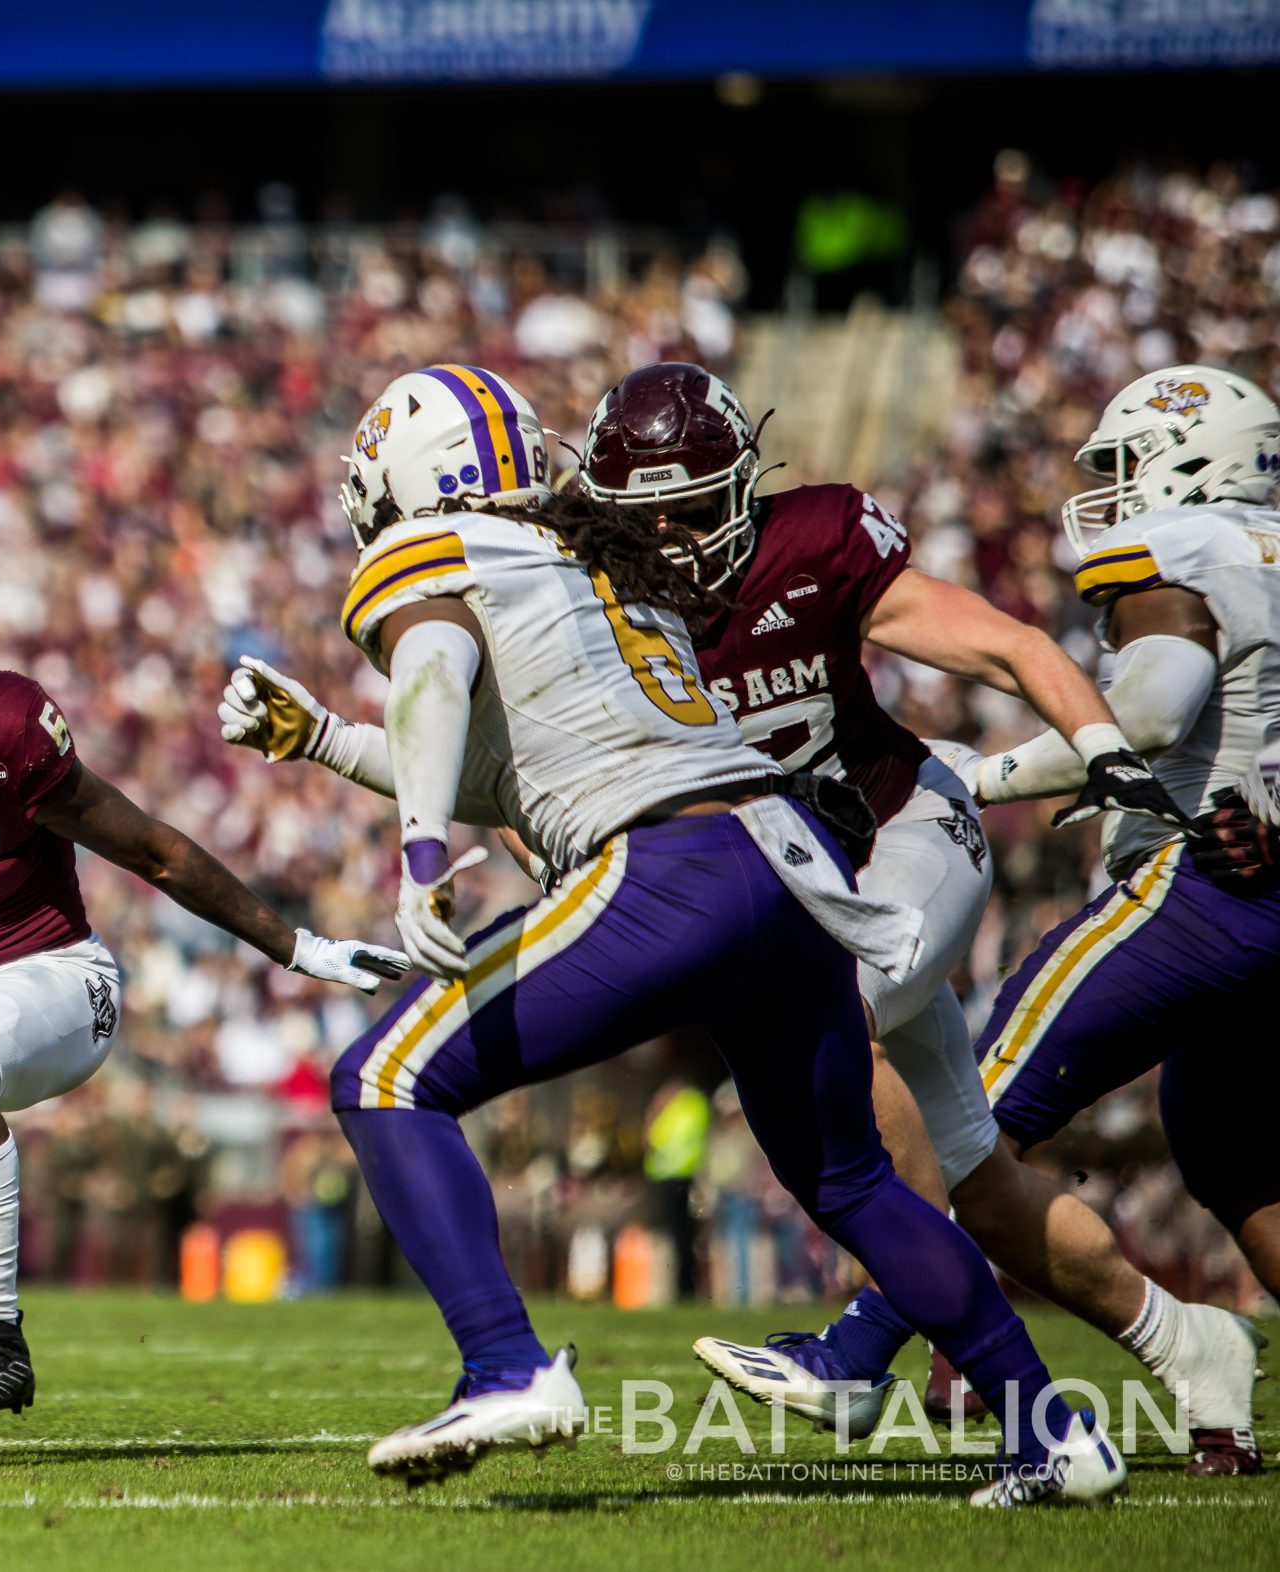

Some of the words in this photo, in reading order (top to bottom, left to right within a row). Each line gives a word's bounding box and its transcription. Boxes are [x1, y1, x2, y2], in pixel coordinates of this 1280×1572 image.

[640, 470, 673, 483] AGGIES
[751, 616, 796, 636] adidas
[743, 653, 830, 708] A&M
